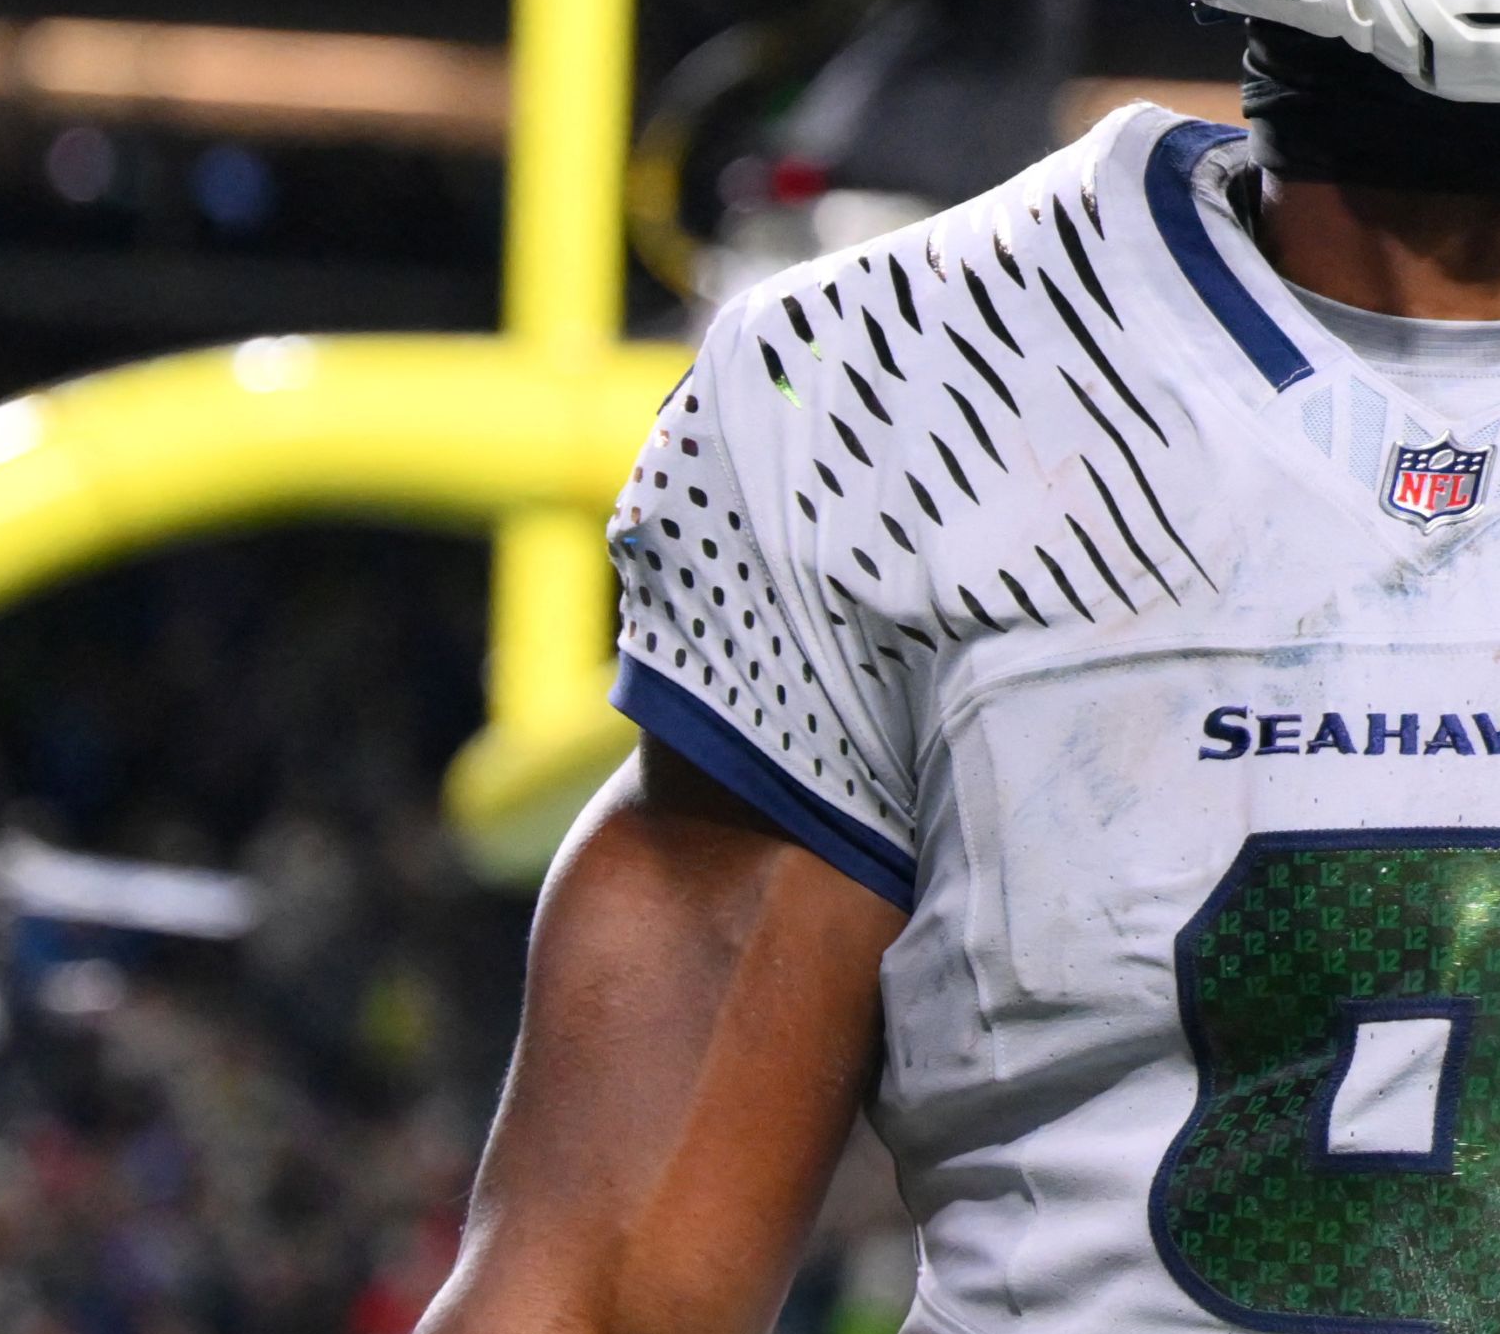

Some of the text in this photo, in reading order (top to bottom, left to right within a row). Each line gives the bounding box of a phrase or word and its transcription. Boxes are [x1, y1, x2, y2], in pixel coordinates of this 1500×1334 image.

[1396, 472, 1469, 511] NFL
[1269, 865, 1289, 887] 12
[1321, 863, 1344, 886] 12
[1244, 888, 1264, 910] 12
[1294, 886, 1316, 908] 12
[1350, 884, 1372, 906] 12
[1220, 911, 1241, 934] 12
[1269, 909, 1289, 931] 12
[1321, 907, 1344, 930] 12
[1377, 906, 1400, 928] 12
[1244, 931, 1265, 954] 12
[1295, 930, 1316, 952] 12
[1350, 928, 1373, 951] 12
[1405, 927, 1428, 949] 12
[1324, 951, 1346, 973] 12
[1378, 950, 1400, 972] 12
[1352, 972, 1374, 995] 12
[1403, 971, 1425, 992] 12
[1457, 970, 1480, 993] 12
[1273, 1078, 1296, 1097] 12
[1245, 1096, 1267, 1113] 12
[1281, 1096, 1304, 1114] 12
[1216, 1114, 1238, 1130] 12
[1253, 1114, 1275, 1132] 12
[1227, 1130, 1246, 1150] 12
[1269, 1133, 1290, 1156] 12
[1198, 1148, 1218, 1166] 12
[1241, 1151, 1262, 1175] 12
[1213, 1170, 1235, 1194] 12
[1186, 1188, 1206, 1210] 12
[1235, 1197, 1258, 1217] 12
[1346, 1201, 1370, 1223] 12
[1210, 1213, 1230, 1236] 12
[1316, 1222, 1340, 1243] 12
[1234, 1238, 1256, 1261] 12
[1289, 1242, 1312, 1264] 12
[1206, 1257, 1227, 1280] 12
[1315, 1266, 1338, 1287] 12
[1341, 1289, 1363, 1311] 12
